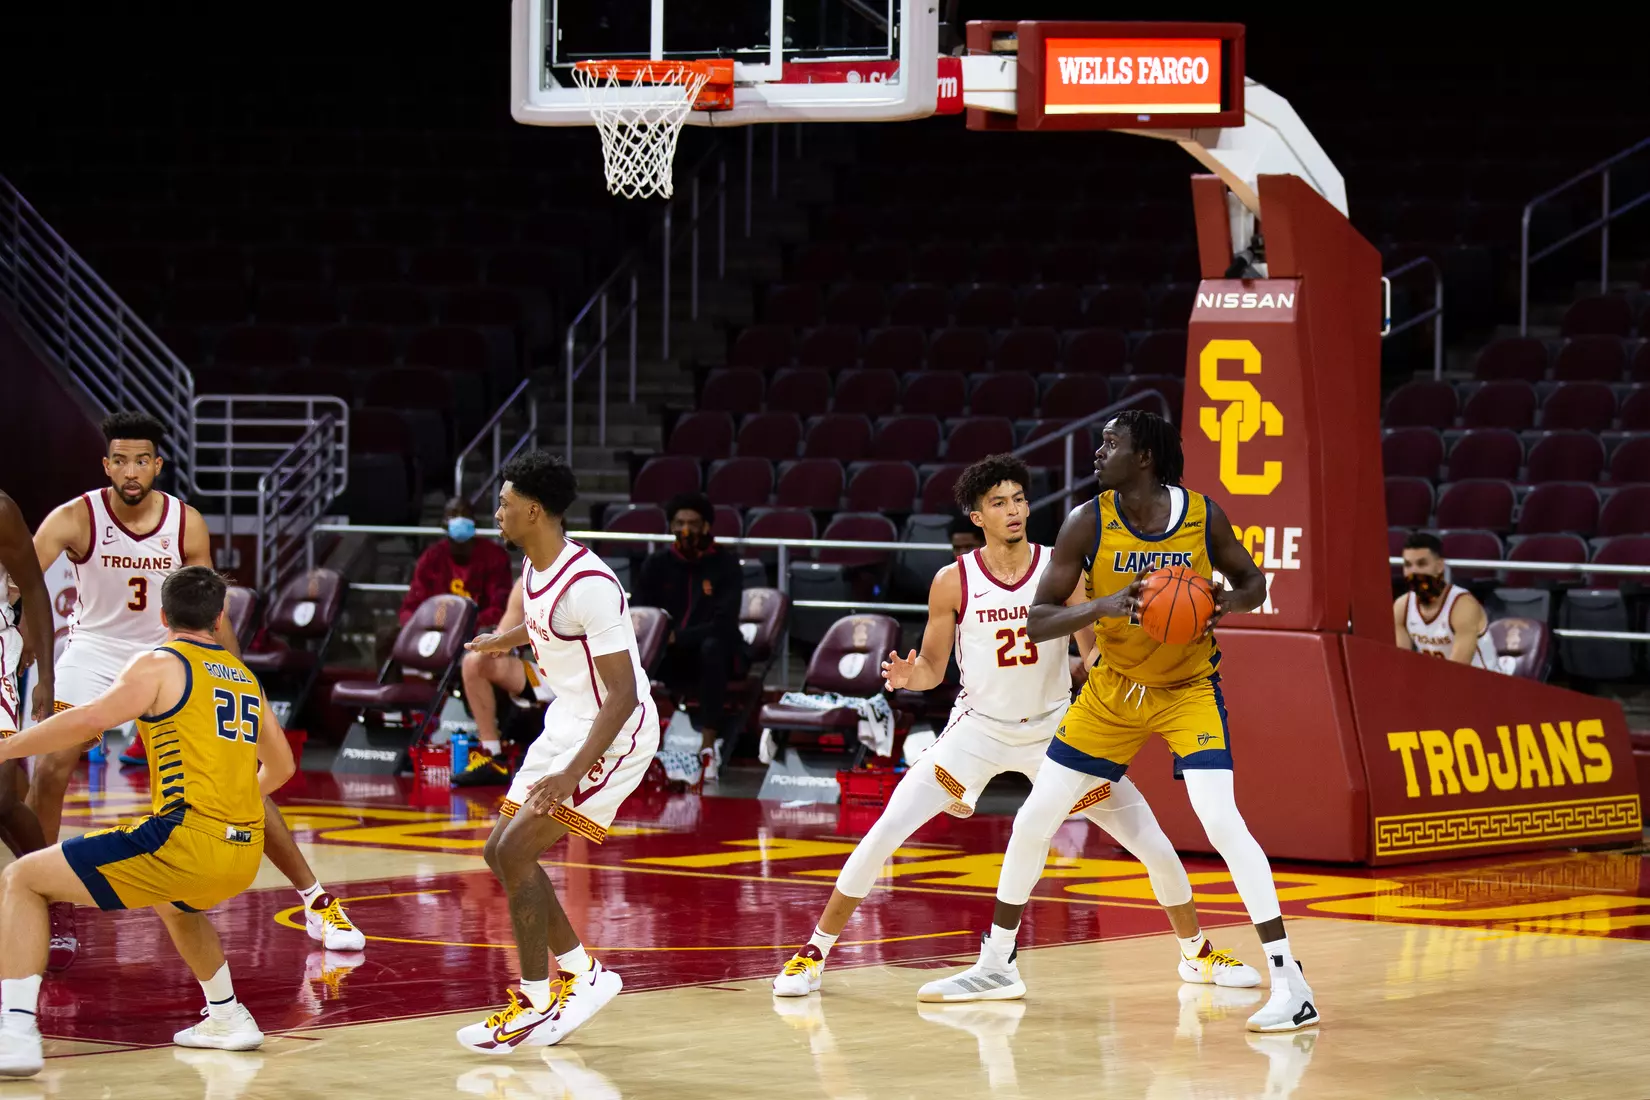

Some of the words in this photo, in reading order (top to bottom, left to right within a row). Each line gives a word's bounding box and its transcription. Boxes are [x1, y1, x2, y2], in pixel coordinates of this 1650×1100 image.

[1058, 56, 1133, 85] WELLS
[1137, 56, 1209, 85] FARGO
[1196, 293, 1295, 308] NISSAN
[106, 526, 113, 538] C
[101, 555, 172, 570] TROJANS
[1113, 551, 1193, 573] LANCERS
[127, 576, 148, 612] 3
[975, 605, 1031, 623] TROJA
[995, 626, 1039, 668] 23
[203, 660, 253, 684] ROWELL
[213, 687, 261, 746] 25
[1387, 719, 1613, 798] TROJANS
